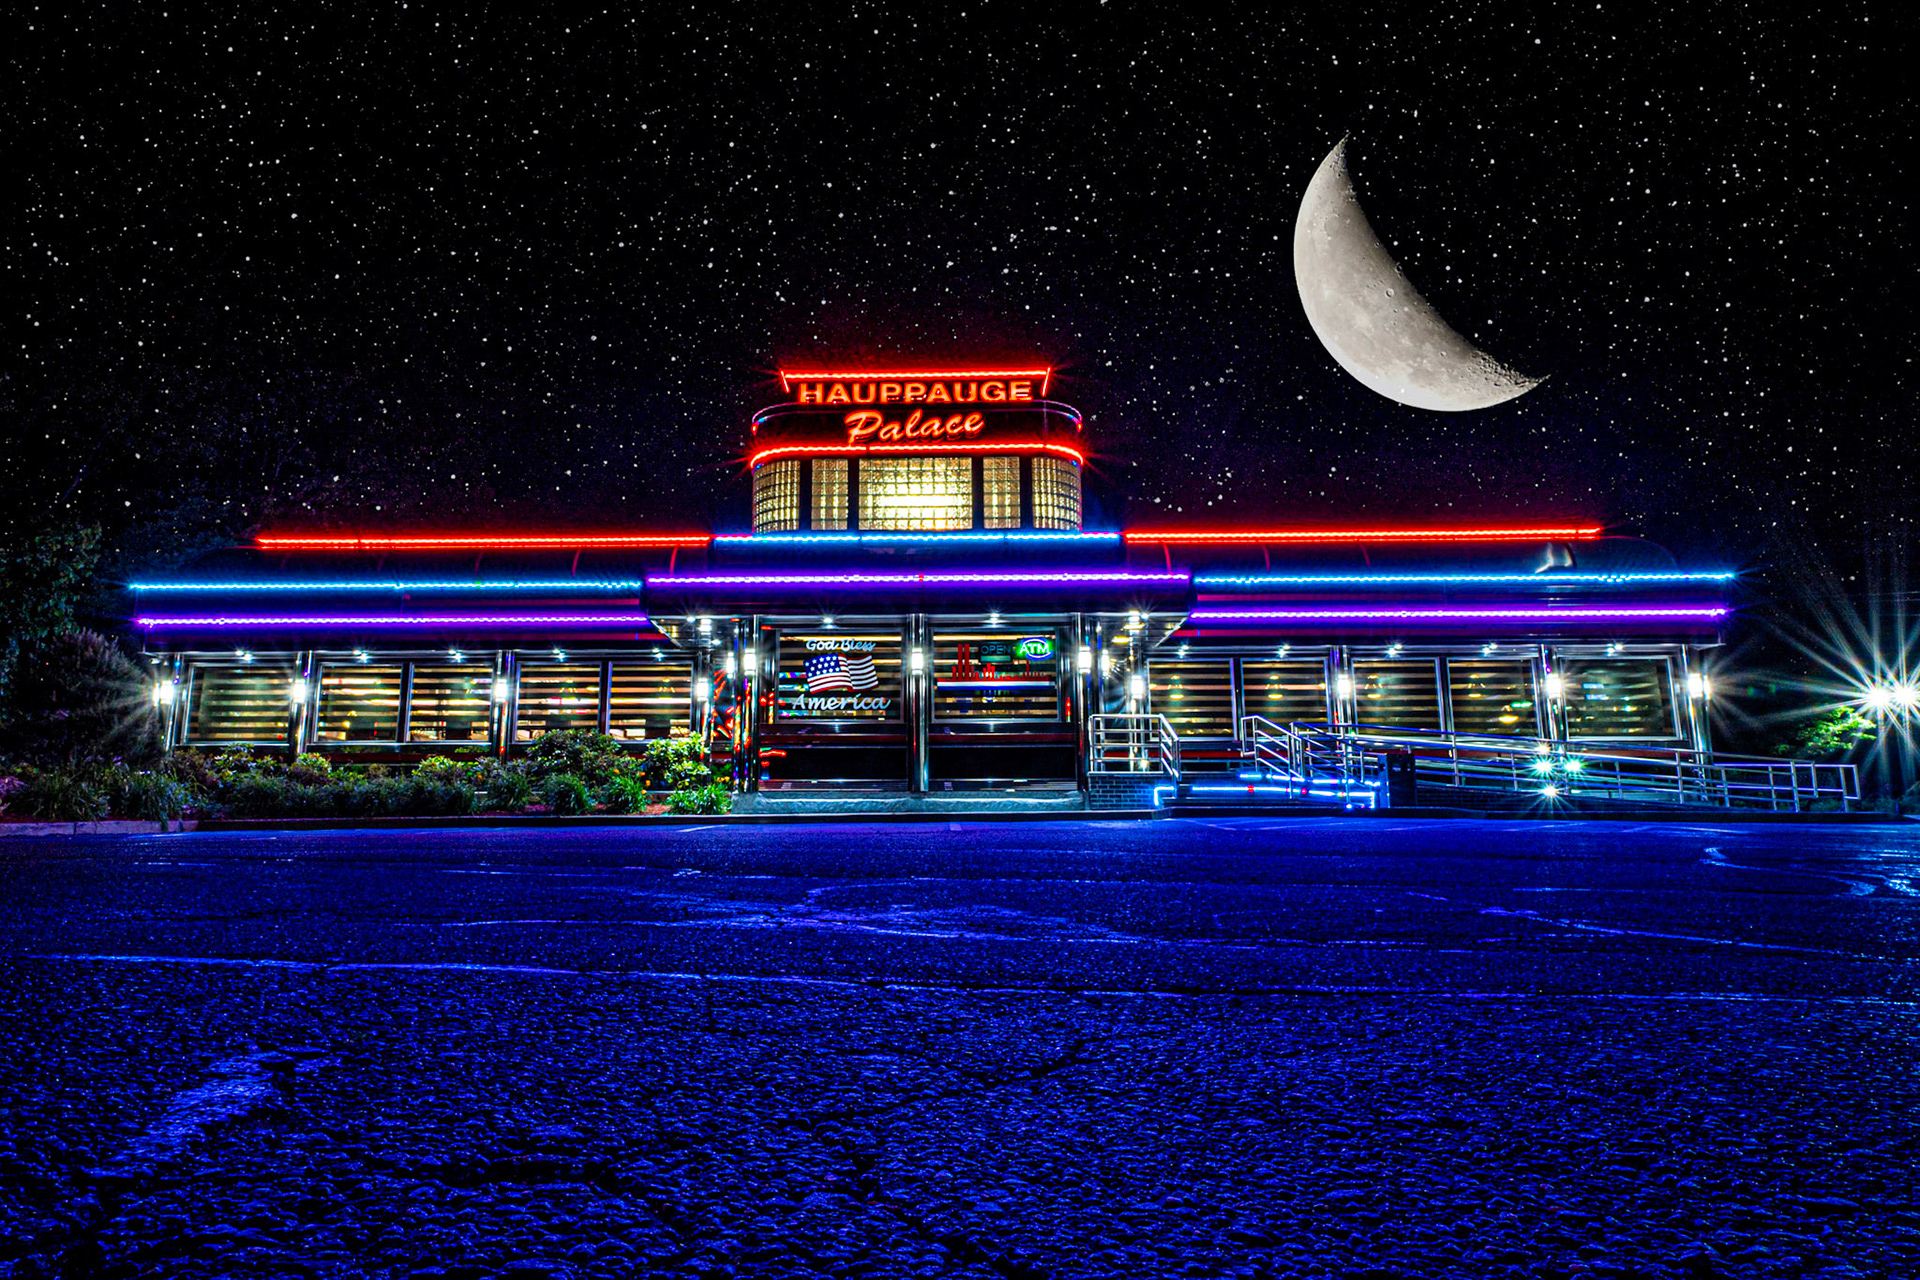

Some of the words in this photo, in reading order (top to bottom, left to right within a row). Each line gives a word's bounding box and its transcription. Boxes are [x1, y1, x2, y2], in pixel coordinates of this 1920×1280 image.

[800, 380, 1033, 404] HAUPPAUGE
[844, 409, 985, 446] Palace
[805, 640, 840, 651] God
[840, 638, 876, 652] Bless
[980, 645, 1011, 655] OPEN
[1019, 642, 1050, 655] ATM
[792, 693, 891, 710] America
